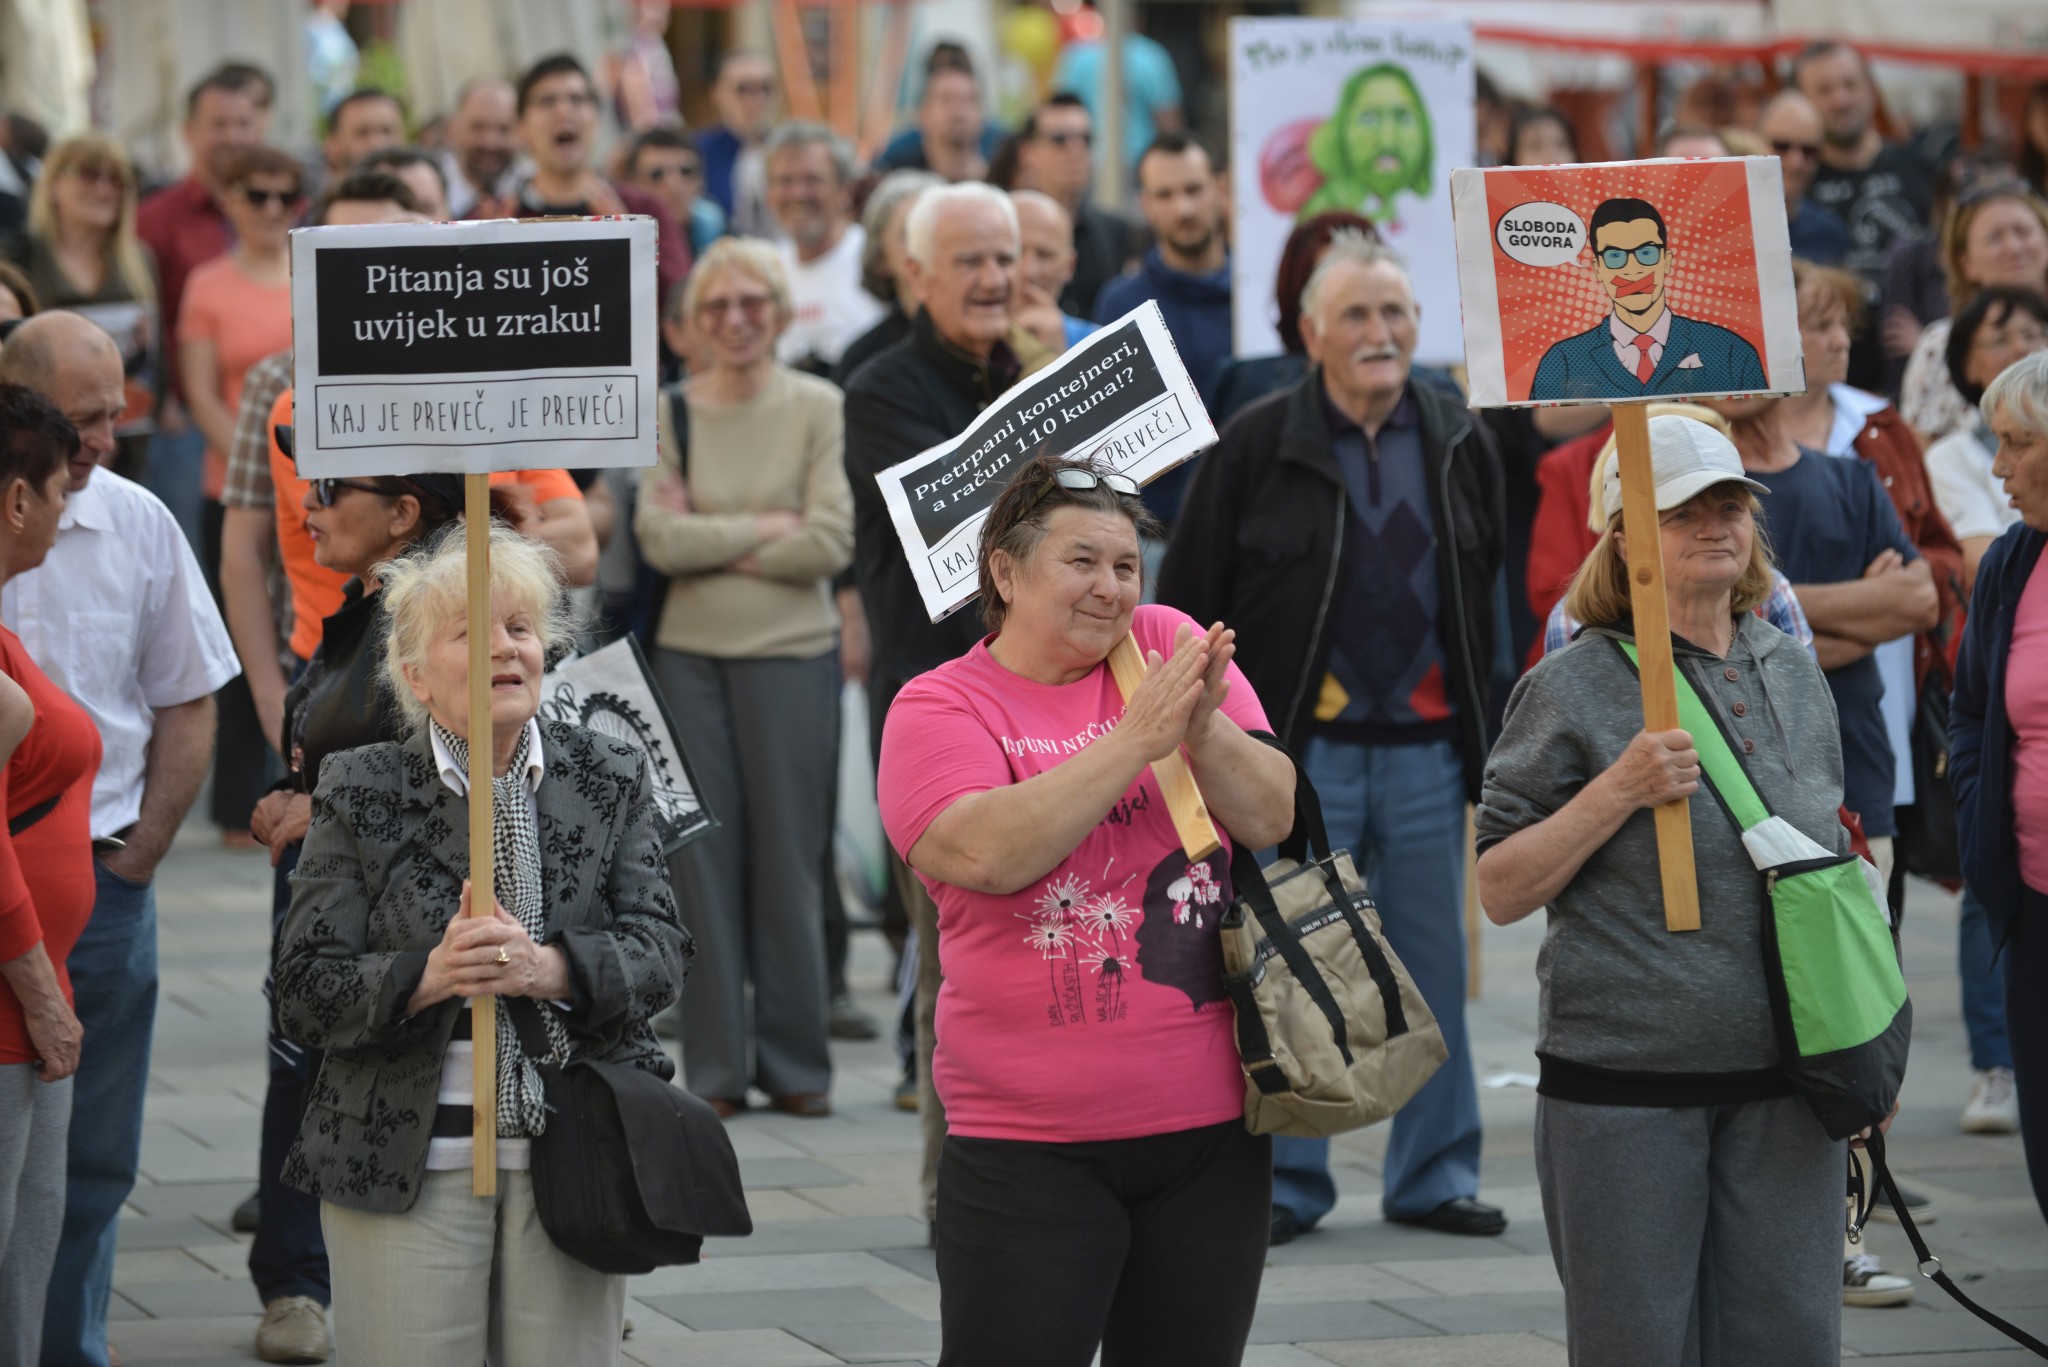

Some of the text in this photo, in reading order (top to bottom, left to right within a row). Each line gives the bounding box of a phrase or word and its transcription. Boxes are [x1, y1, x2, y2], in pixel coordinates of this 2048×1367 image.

[1504, 219, 1578, 235] SLOBODA
[1508, 234, 1574, 249] GOVORA
[366, 256, 589, 299] Pitanja su još
[353, 304, 601, 347] uvijek u zraku!
[328, 383, 625, 435] KAJ JE PREVEČ, JE PREVEČ!
[914, 419, 1014, 501] Pretrpani
[1016, 341, 1139, 426] kontejneri,
[932, 366, 1135, 513] a račun 110 kuna!?
[942, 410, 1175, 576] KAJ PREVEČ!
